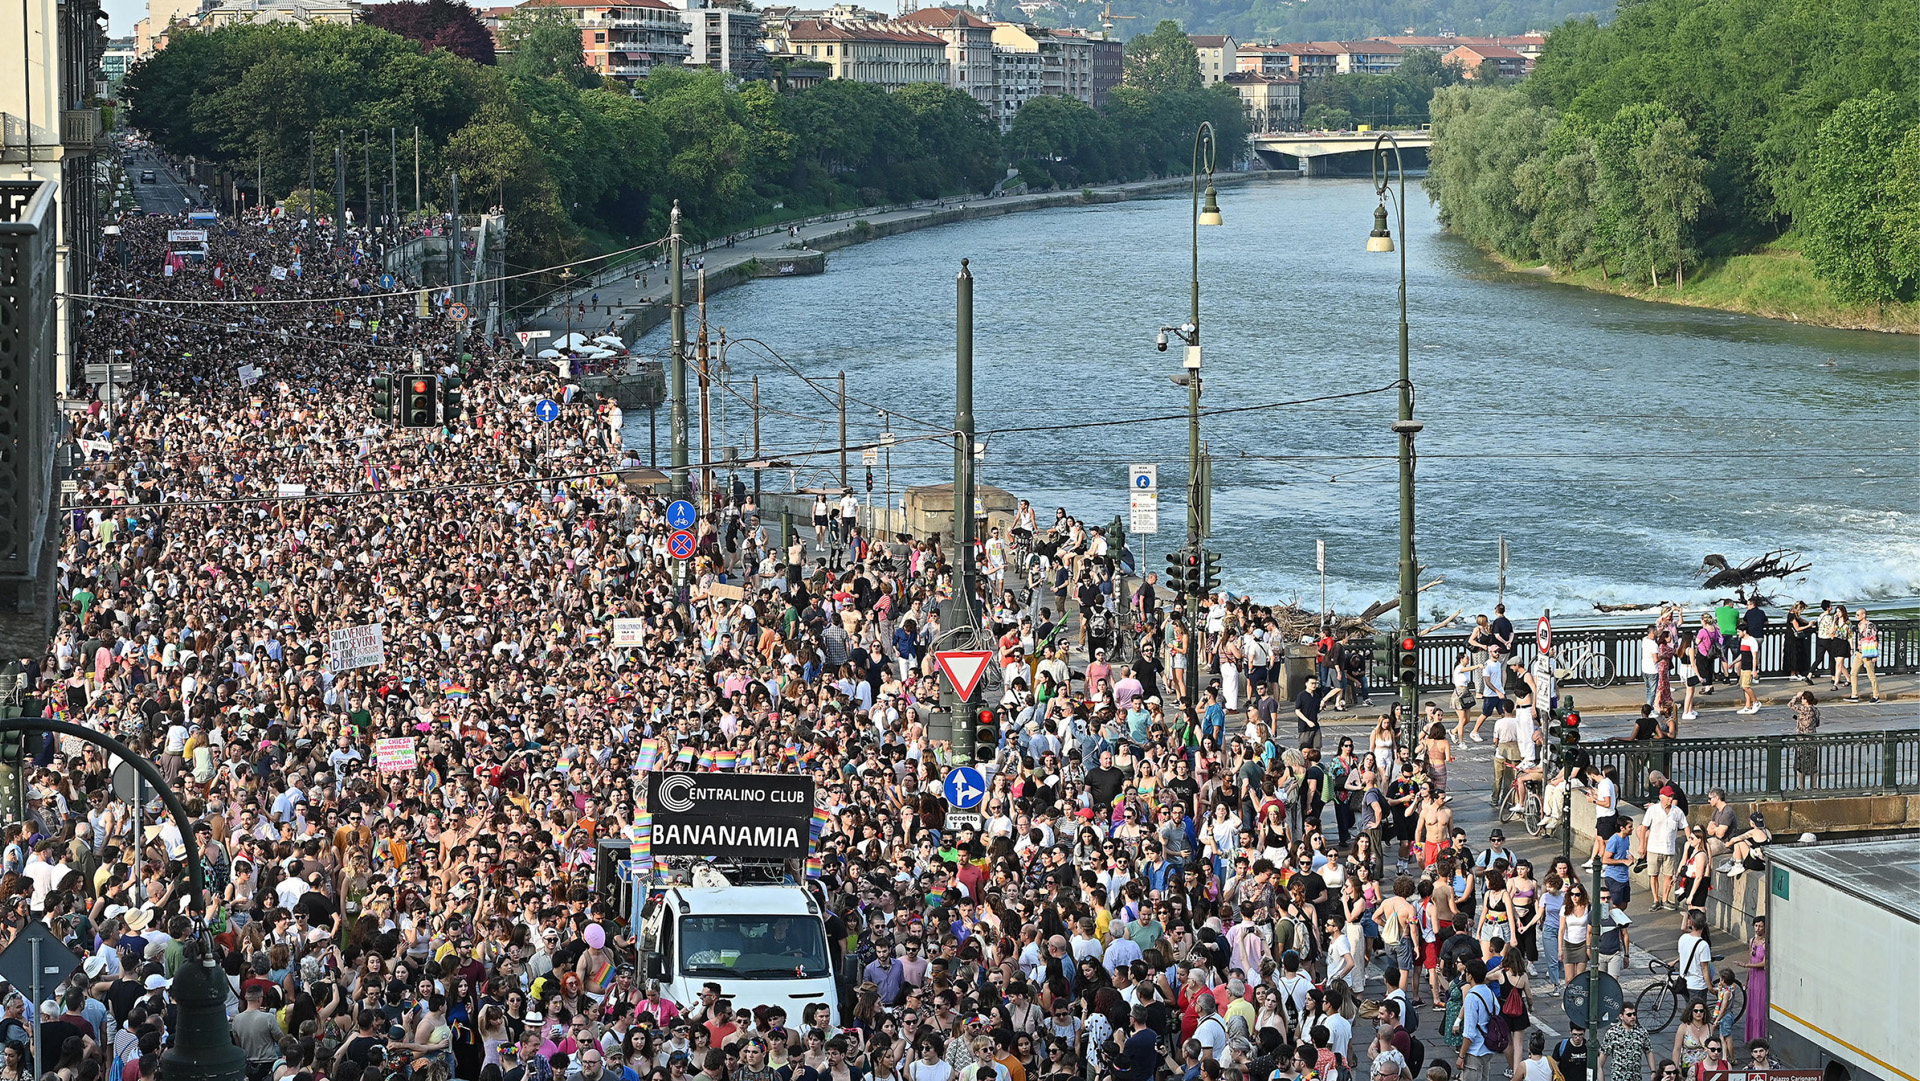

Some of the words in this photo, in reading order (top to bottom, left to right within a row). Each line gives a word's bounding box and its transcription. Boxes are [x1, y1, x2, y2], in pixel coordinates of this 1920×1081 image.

[521, 332, 528, 343] R
[82, 440, 91, 454] R
[658, 774, 766, 812] CENTRALINO
[770, 790, 805, 803] CLUB
[652, 824, 800, 848] BANANAMIA
